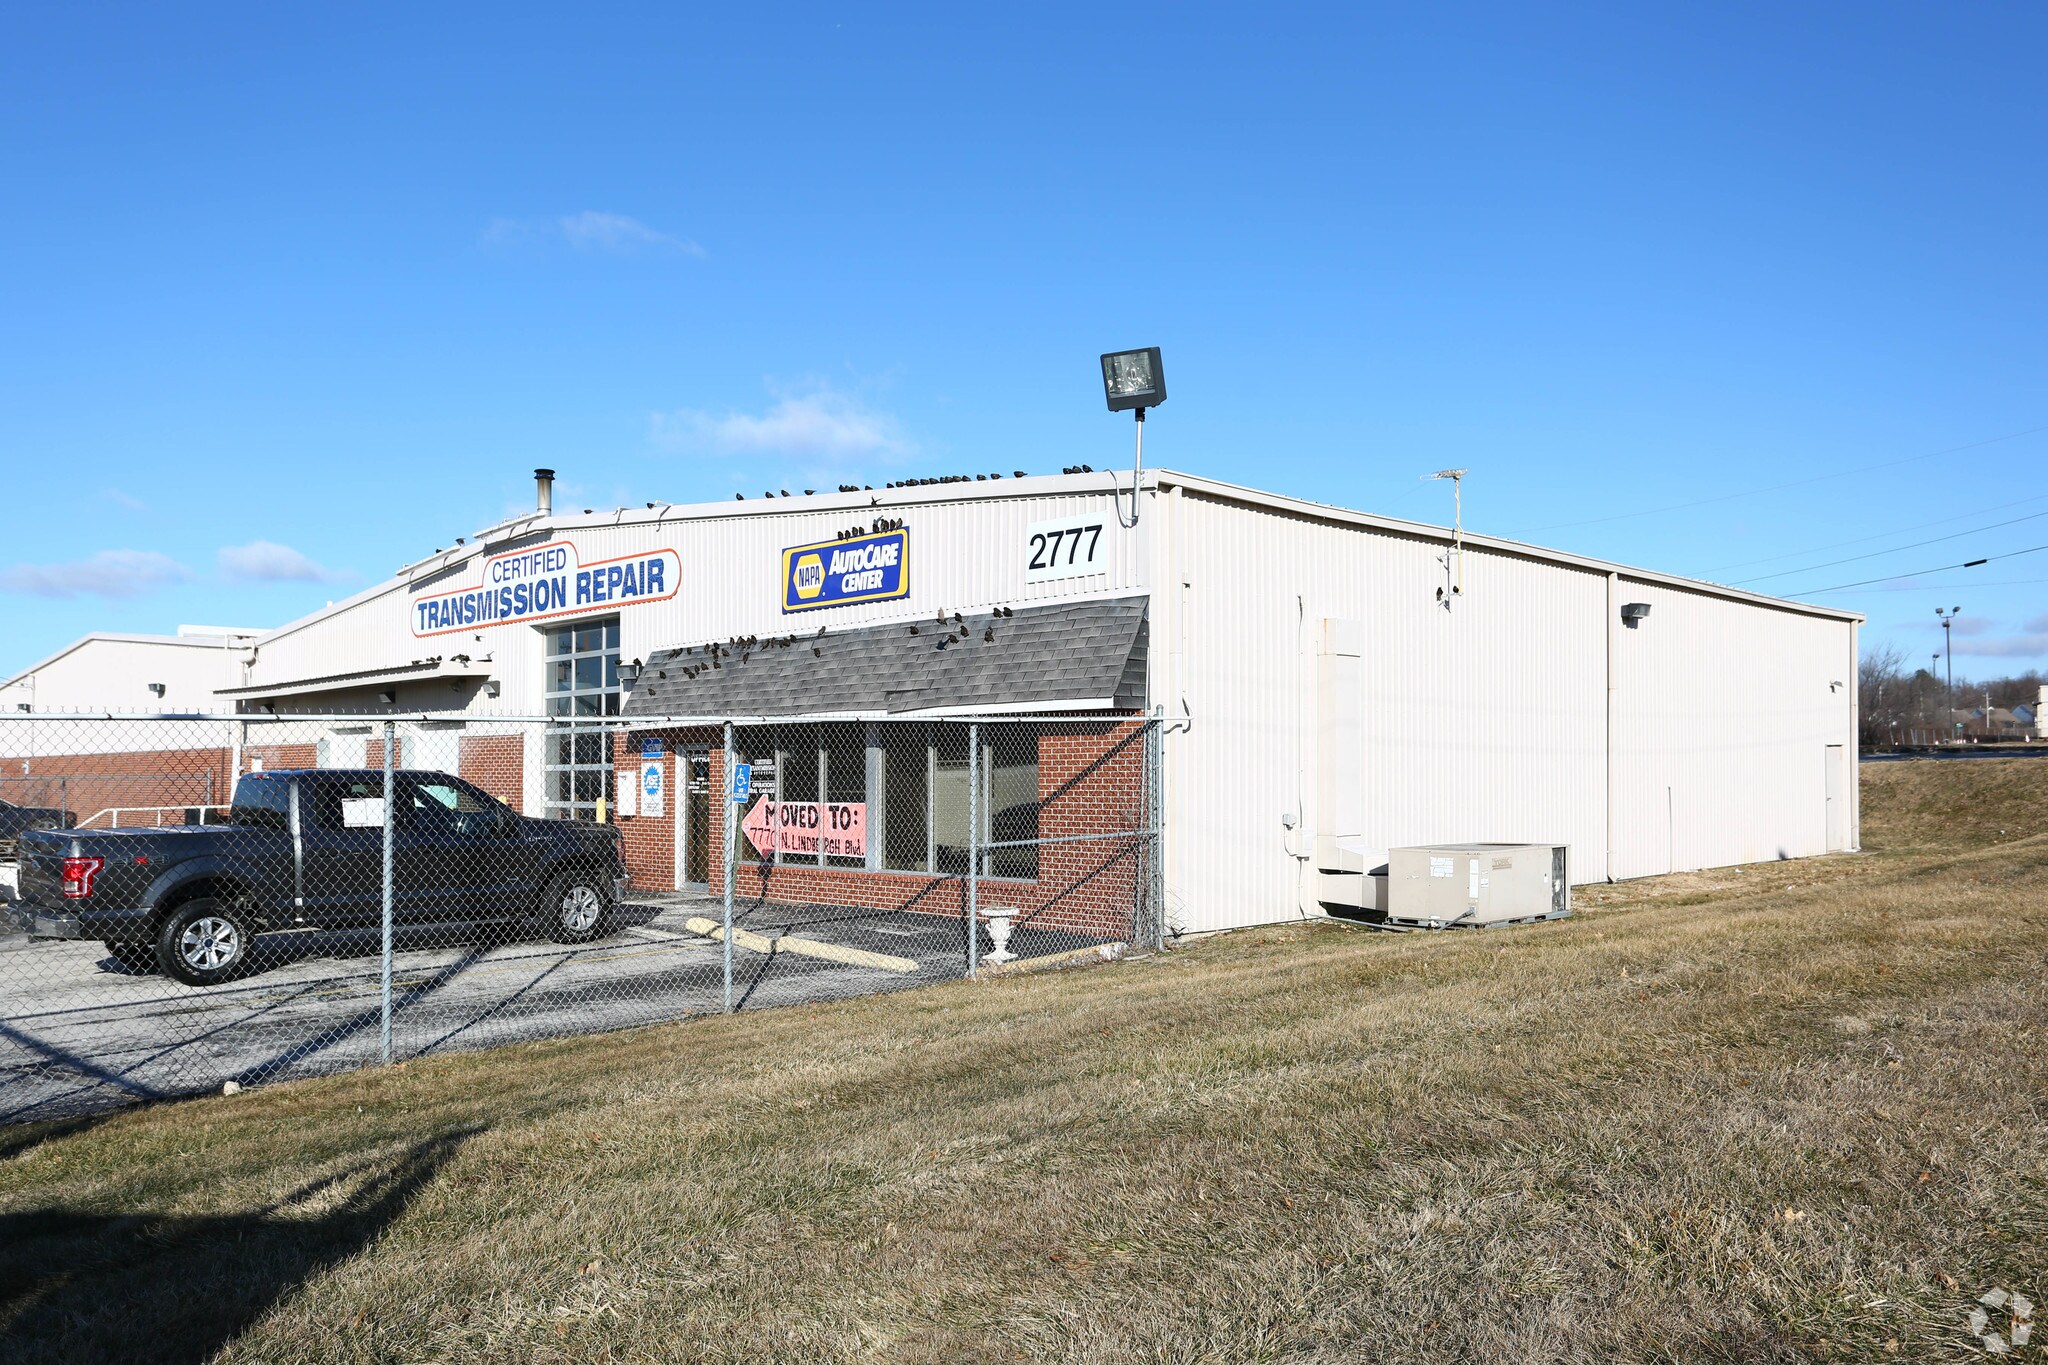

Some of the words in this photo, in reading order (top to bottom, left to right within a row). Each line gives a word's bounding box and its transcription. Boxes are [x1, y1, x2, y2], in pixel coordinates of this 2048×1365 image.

[1028, 524, 1103, 570] 2777
[492, 548, 567, 583] CERTIFIED
[799, 565, 820, 588] NAPA
[418, 576, 566, 630] TRANSMISSION
[576, 558, 665, 604] REPAIR
[841, 569, 884, 593] CENTER
[765, 805, 819, 829] MOVED
[829, 806, 858, 830] TO:
